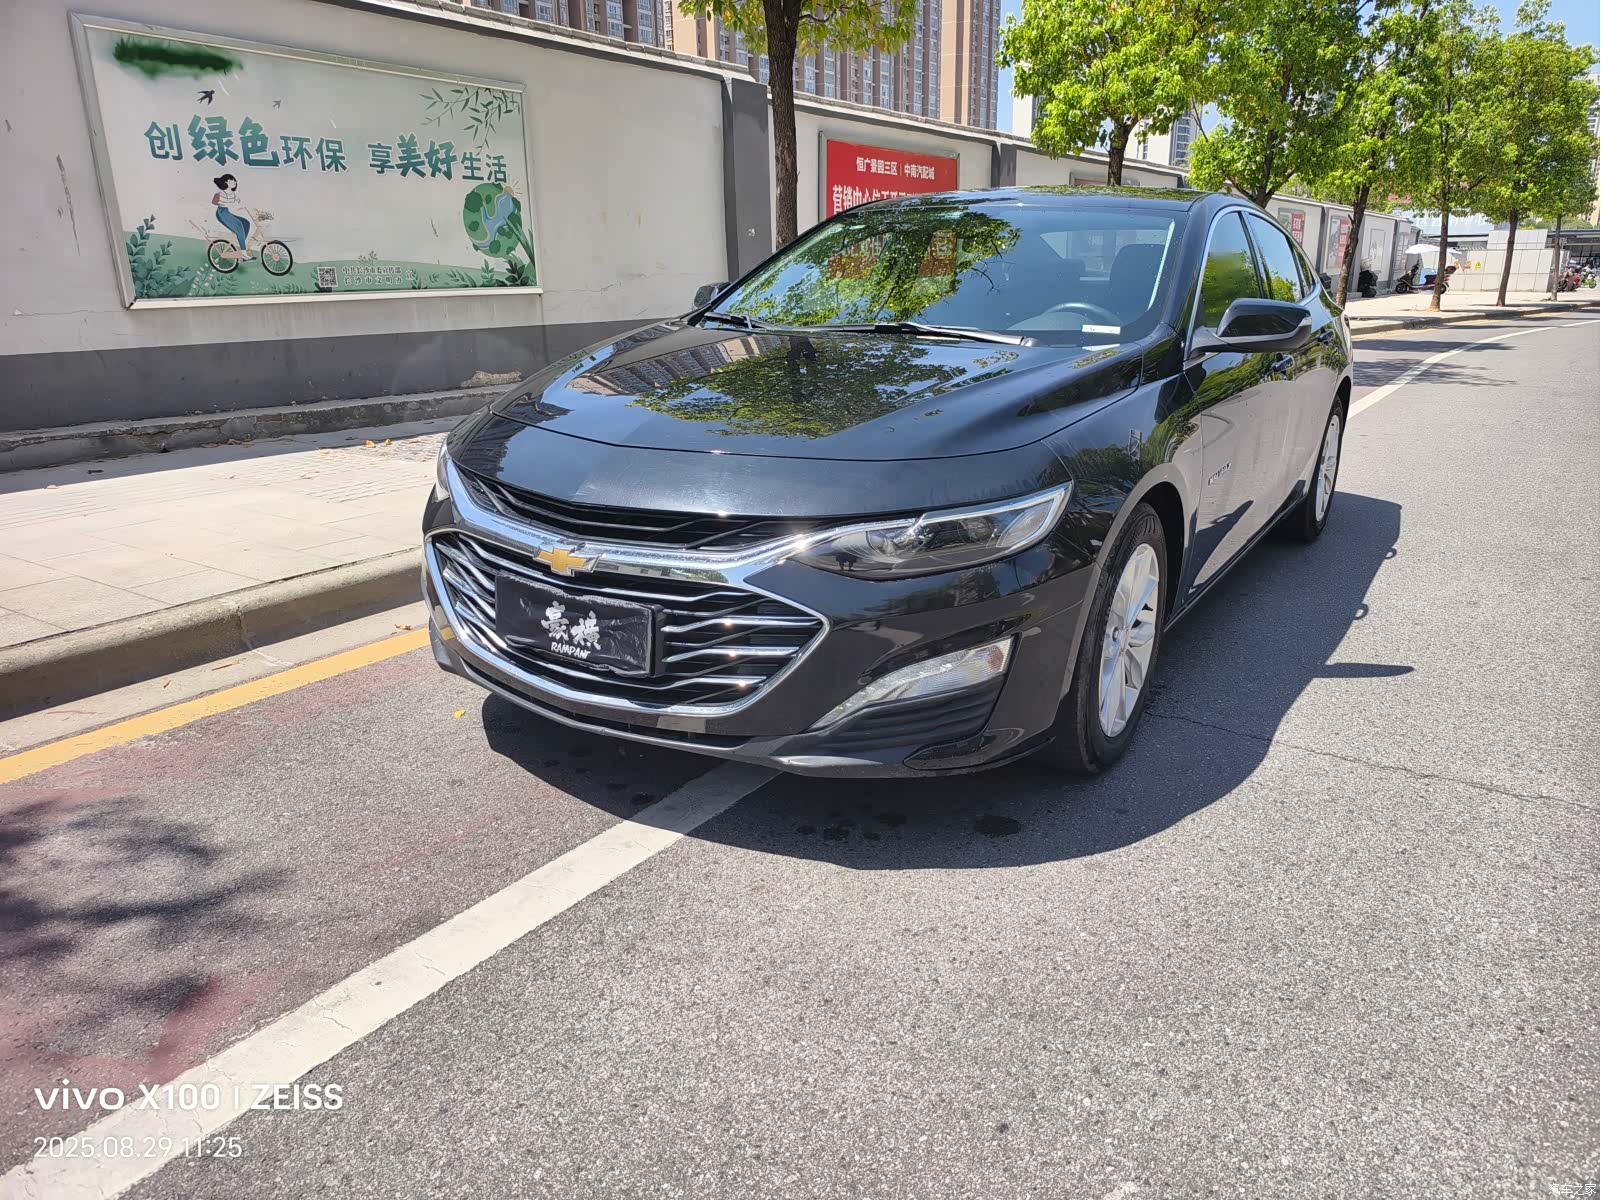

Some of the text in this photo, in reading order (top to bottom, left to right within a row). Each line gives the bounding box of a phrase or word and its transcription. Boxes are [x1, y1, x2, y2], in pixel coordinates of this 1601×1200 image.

[143, 114, 508, 183] 创绿色环保 享美好生活
[856, 156, 935, 180] 恒广景园三区 中南汽配城
[541, 600, 602, 650] 豪横
[550, 641, 591, 660] RAMPANT
